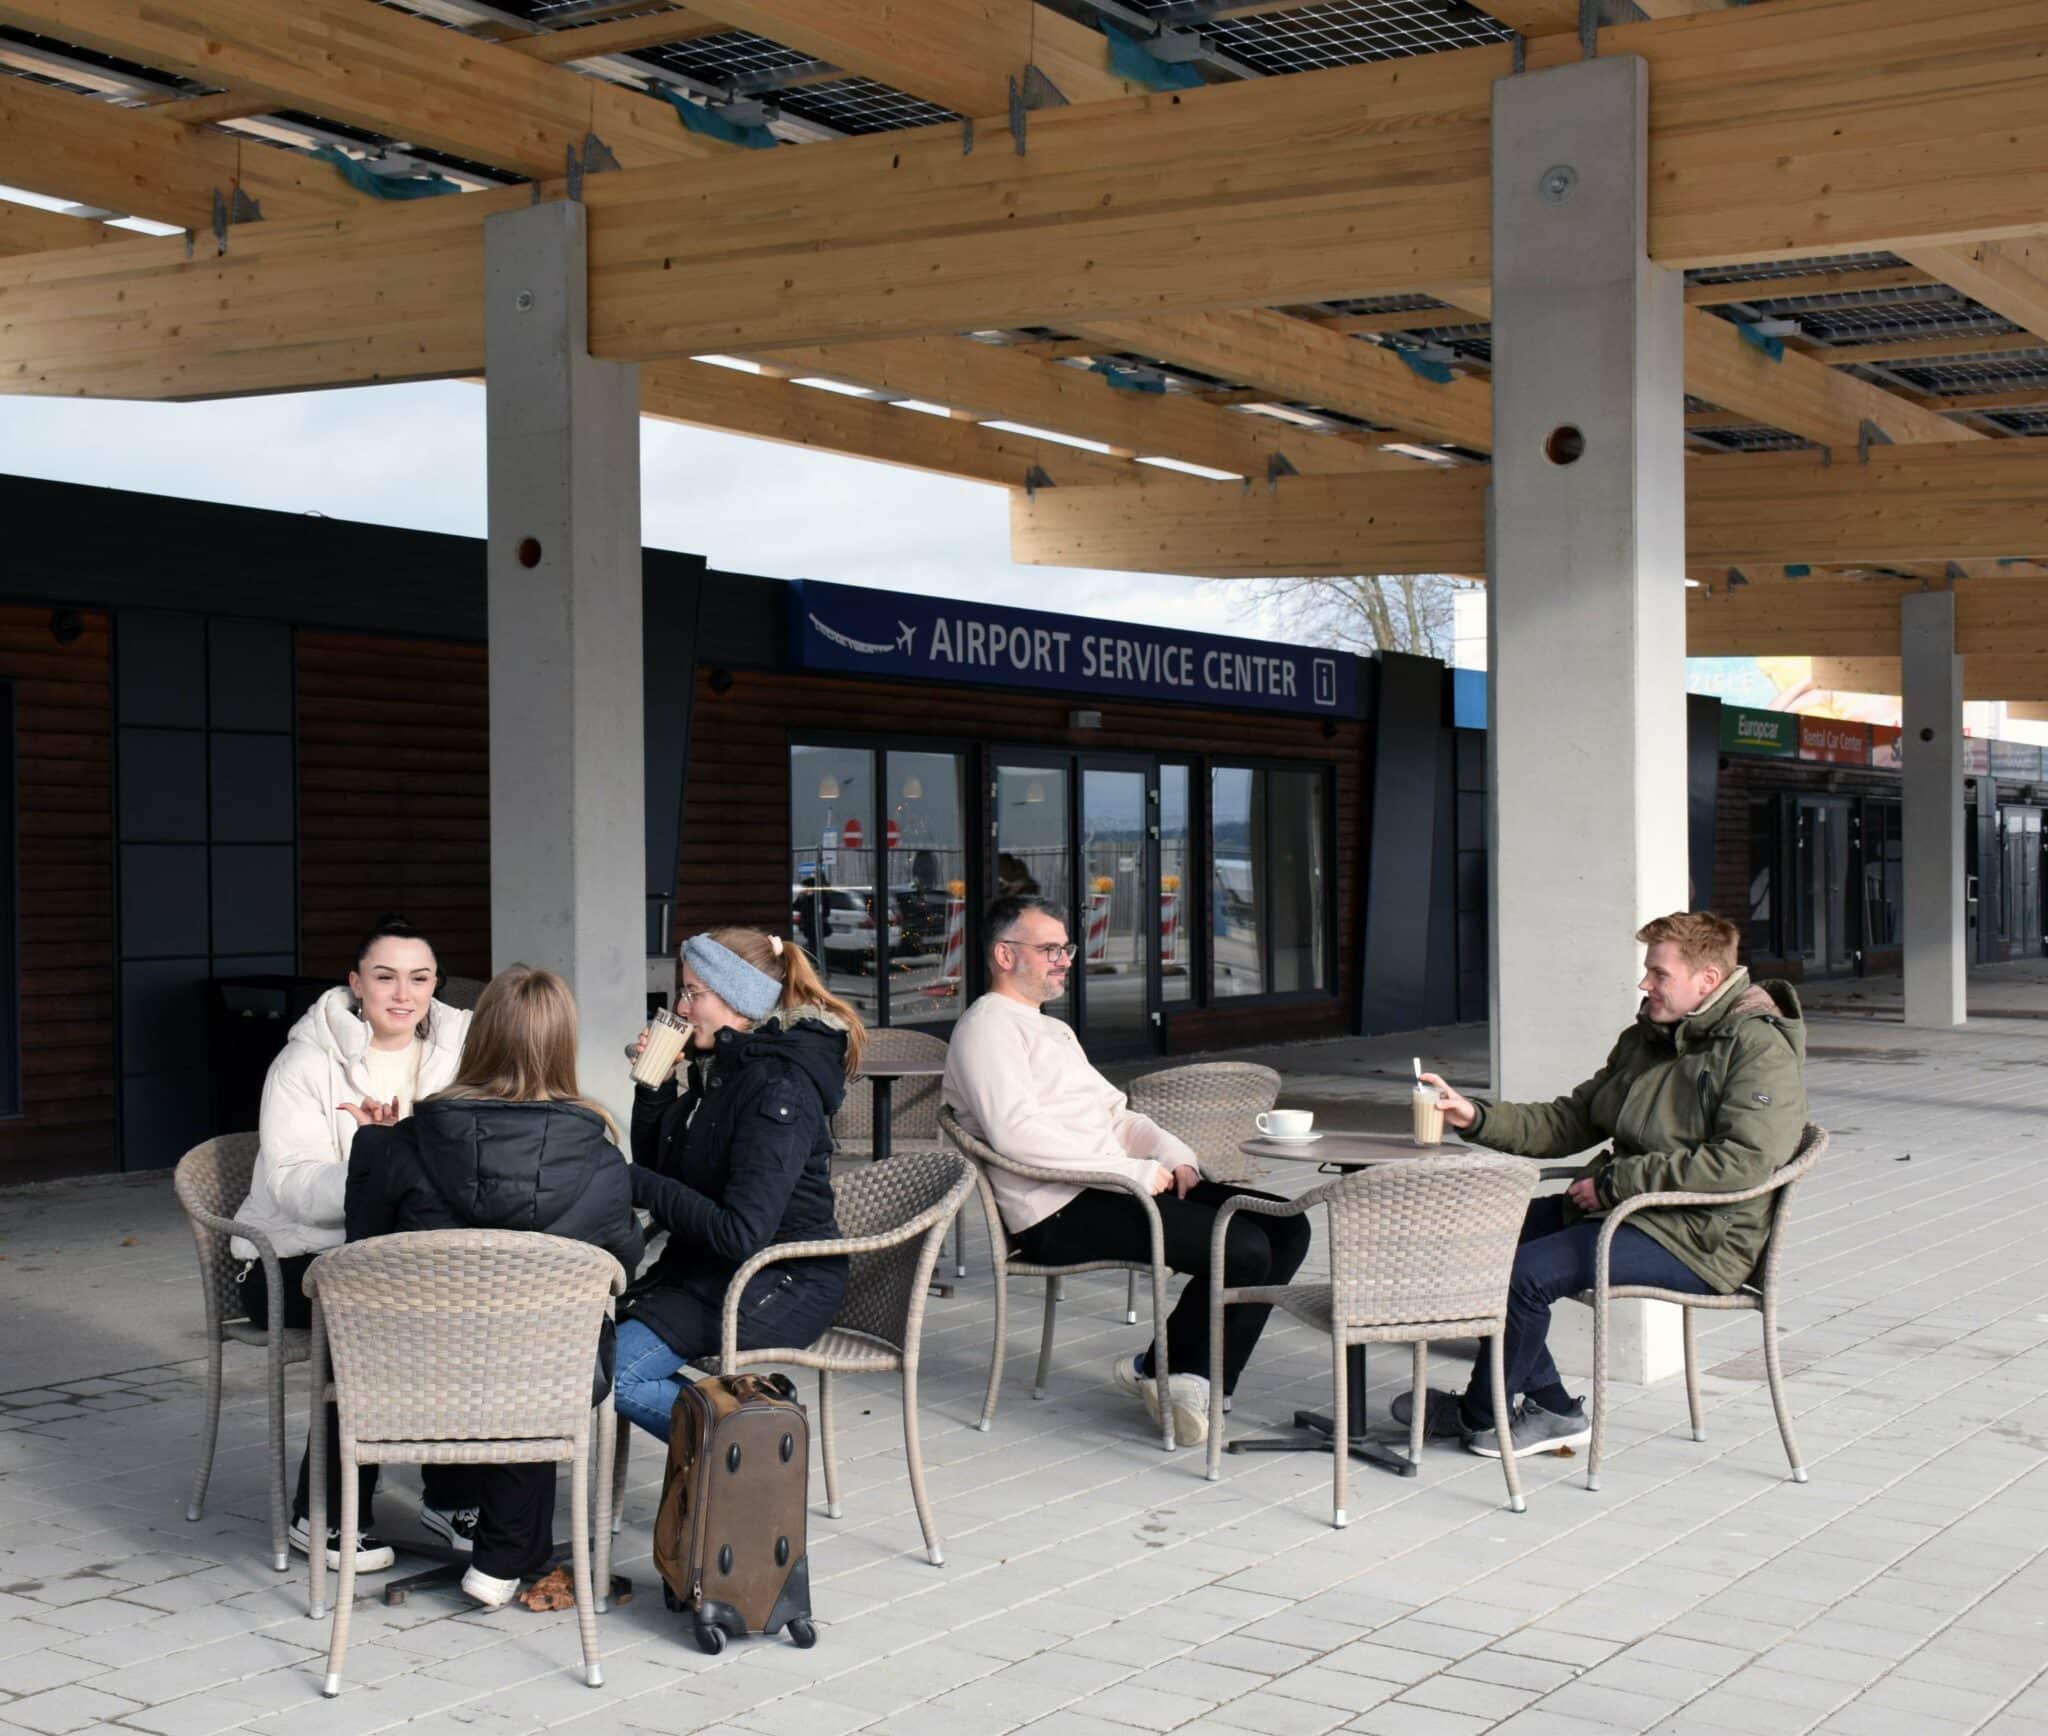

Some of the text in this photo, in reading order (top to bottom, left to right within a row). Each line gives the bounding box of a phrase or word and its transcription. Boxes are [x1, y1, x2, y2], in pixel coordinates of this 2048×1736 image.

[929, 617, 1071, 673] AIRPORT
[1082, 635, 1194, 686] SERVICE
[1203, 651, 1297, 697] CENTER
[1738, 714, 1779, 740] Europcar
[1803, 728, 1863, 752] Rental Car Center
